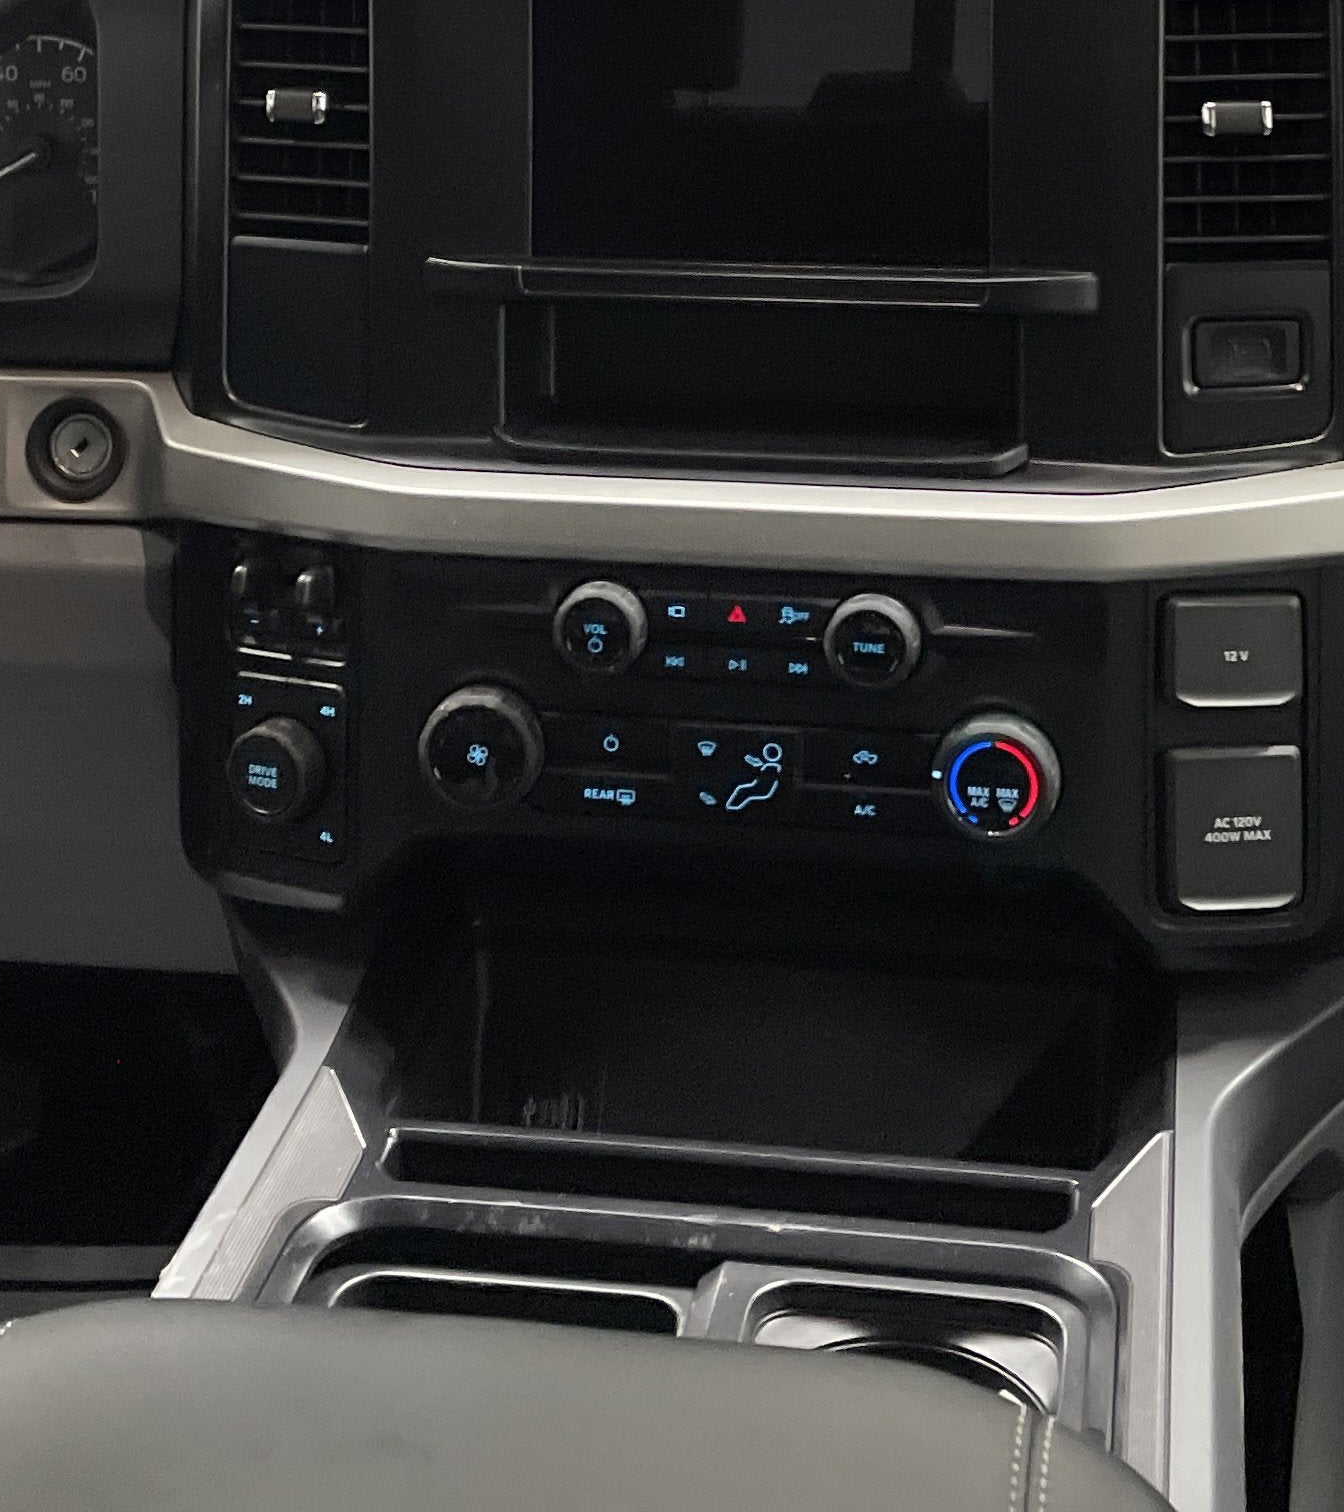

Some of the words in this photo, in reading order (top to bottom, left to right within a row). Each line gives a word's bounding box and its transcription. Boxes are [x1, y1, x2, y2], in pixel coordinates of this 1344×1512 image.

[61, 66, 87, 83] 60
[583, 623, 607, 636] VOL
[853, 642, 885, 655] TUNE
[1223, 651, 1237, 662] 12
[1238, 650, 1249, 662] V
[238, 694, 253, 706] 2H
[319, 705, 336, 717] 4H
[248, 764, 278, 778] DRIVE
[248, 776, 278, 790] MODE
[584, 788, 615, 801] REAR
[967, 786, 990, 797] MAX
[996, 787, 1019, 799] MAX
[854, 804, 876, 817] A/C
[1213, 816, 1232, 830] AC
[1233, 816, 1262, 829] 120V
[319, 831, 334, 843] 4L
[1205, 830, 1241, 844] 400W
[1243, 829, 1272, 842] MAX
